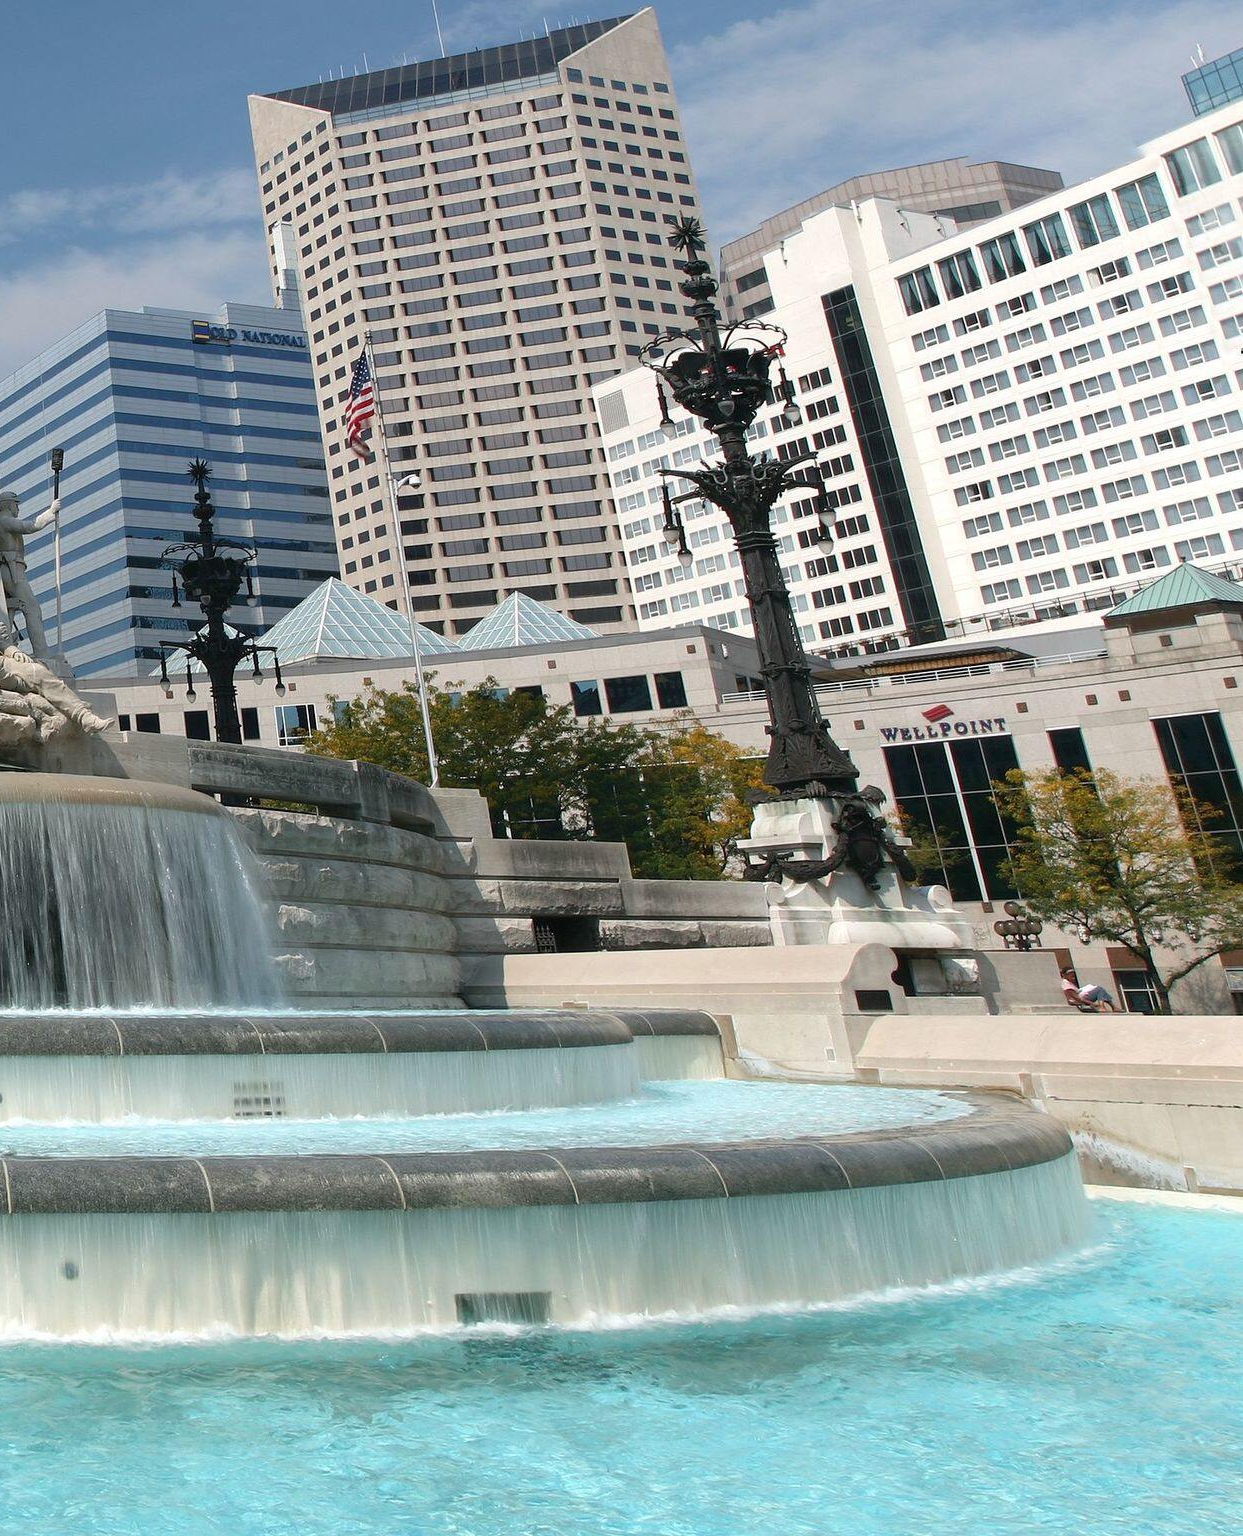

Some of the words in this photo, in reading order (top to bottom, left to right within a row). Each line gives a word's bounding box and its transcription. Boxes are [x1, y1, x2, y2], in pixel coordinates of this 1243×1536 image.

[211, 327, 237, 340] OLD
[242, 330, 306, 348] NATIONAL
[880, 717, 1006, 742] WELLPOINT
